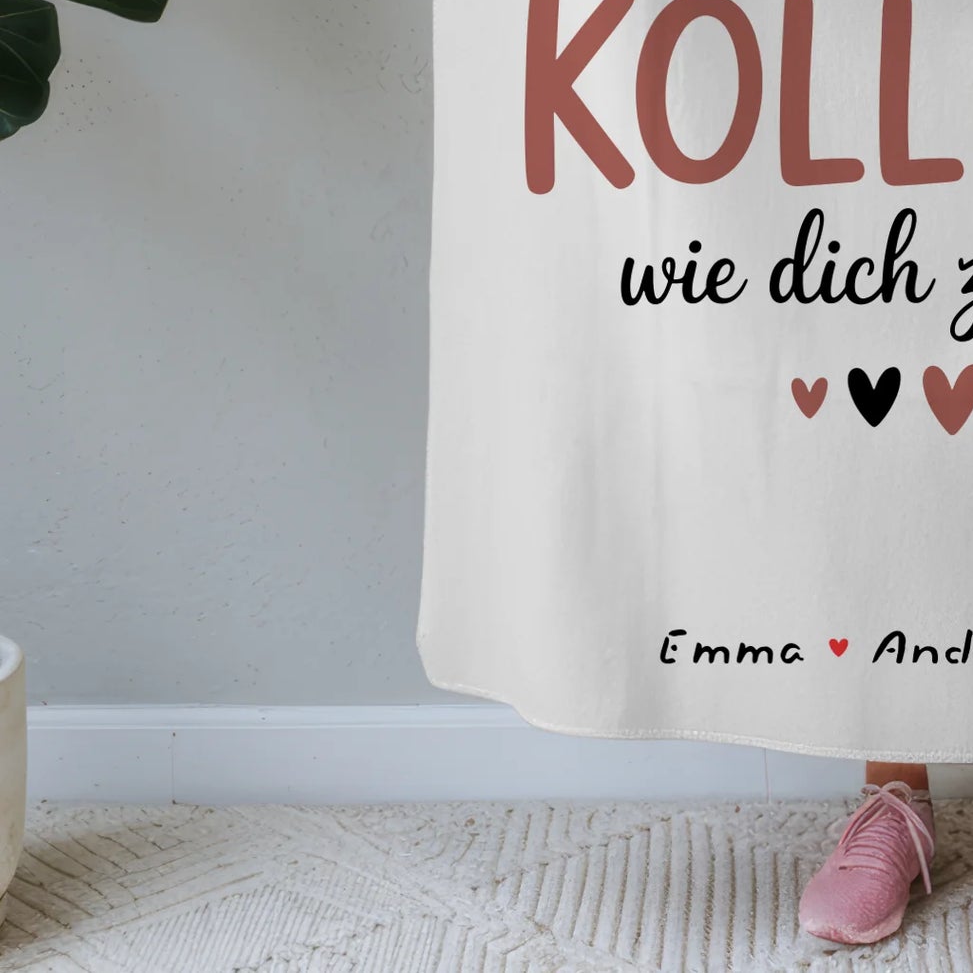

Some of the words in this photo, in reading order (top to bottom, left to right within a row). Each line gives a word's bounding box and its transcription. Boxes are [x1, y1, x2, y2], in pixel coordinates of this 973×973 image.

[620, 239, 749, 306] wie
[769, 207, 937, 305] dich
[659, 628, 805, 665] Emma
